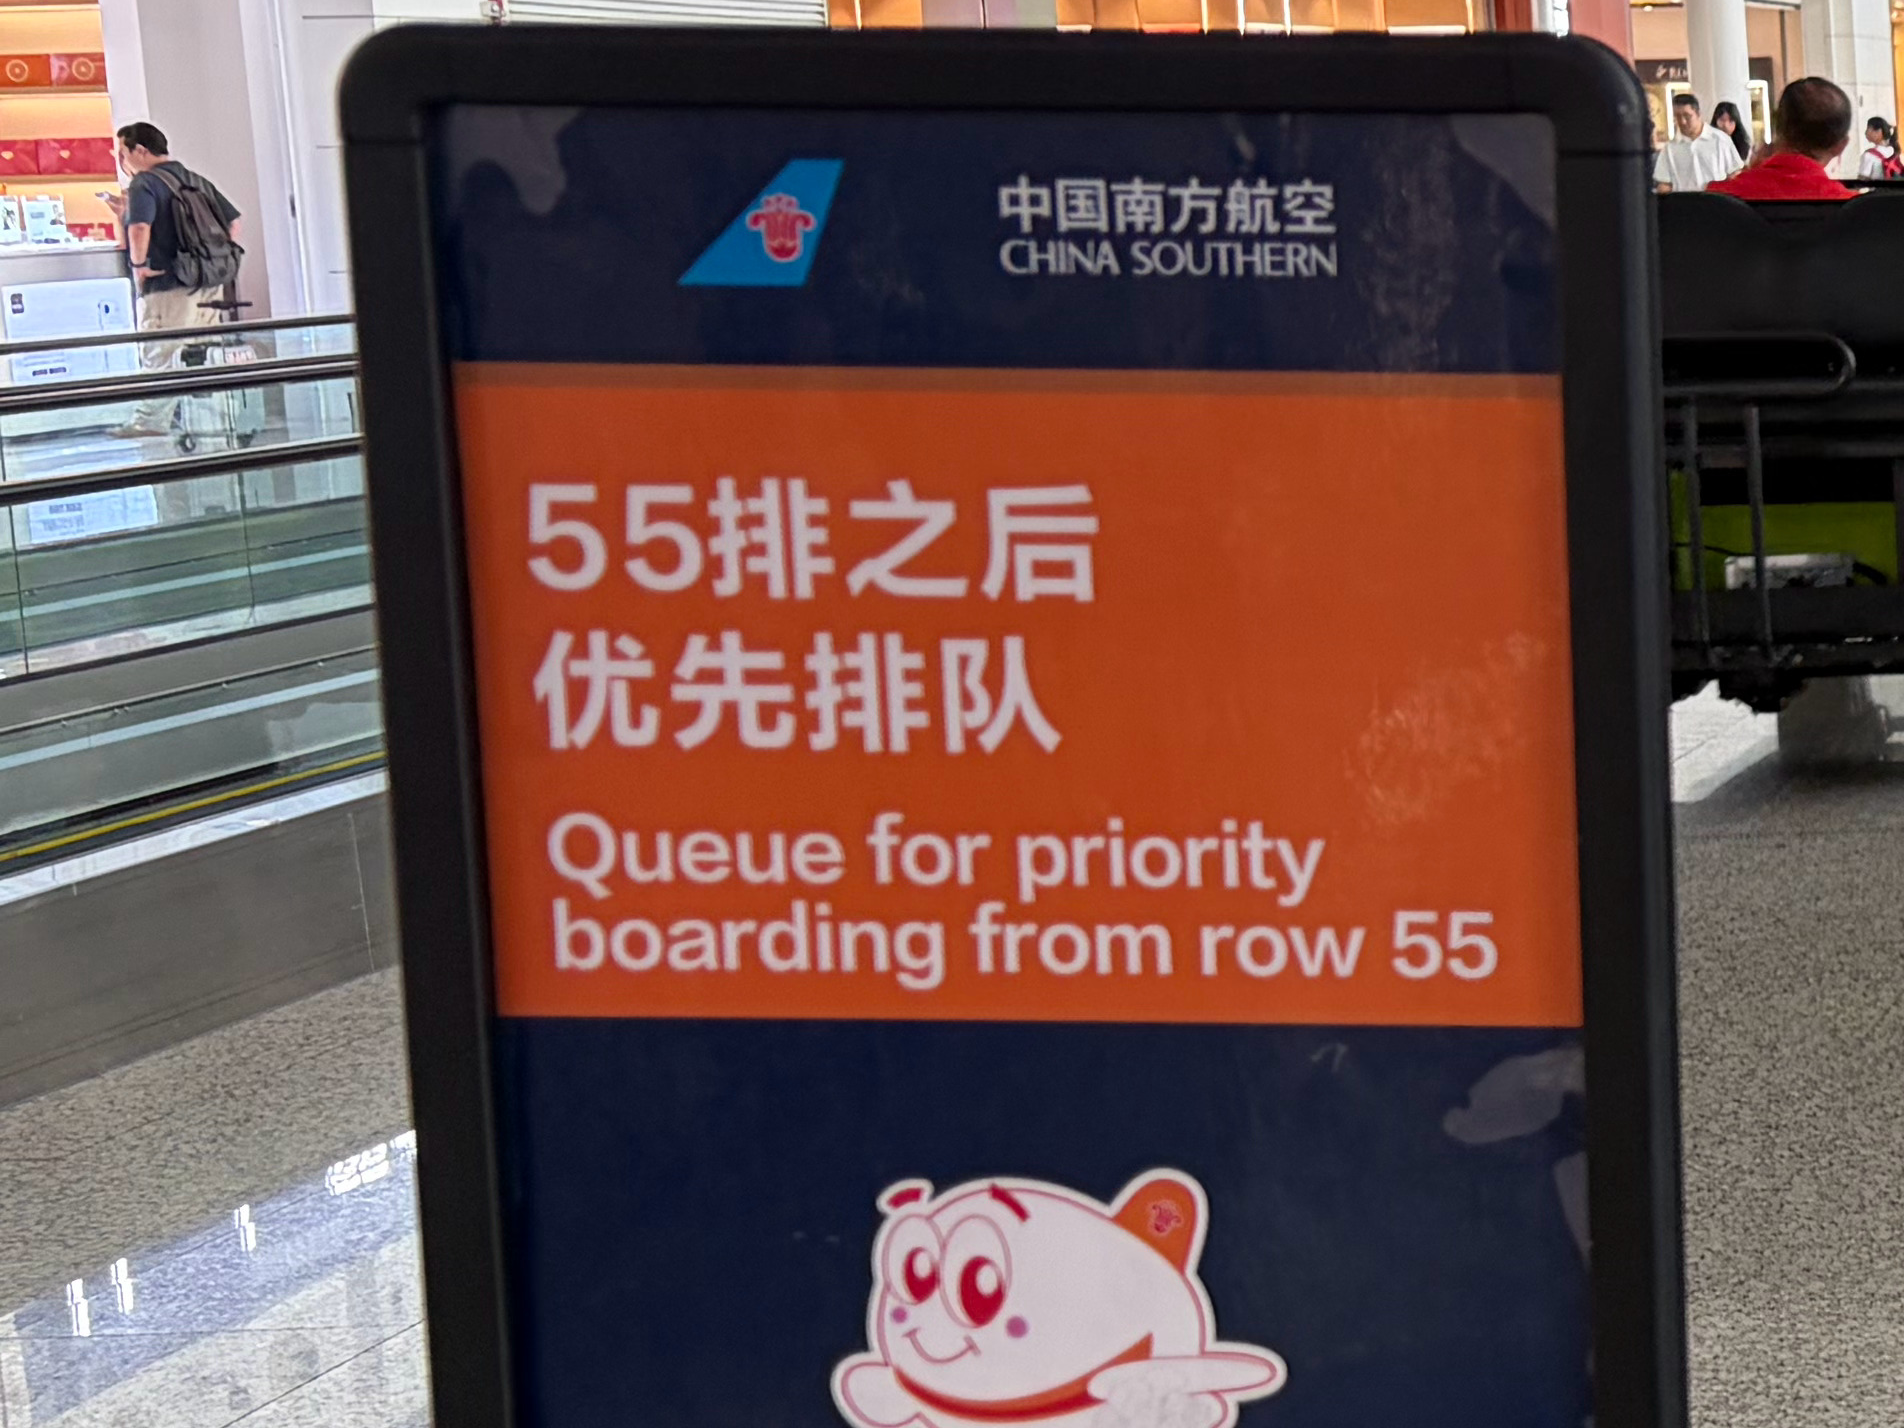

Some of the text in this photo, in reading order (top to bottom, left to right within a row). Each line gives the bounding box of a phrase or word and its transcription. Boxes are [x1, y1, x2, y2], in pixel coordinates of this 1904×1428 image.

[998, 175, 1338, 236] 中国南方航空
[998, 236, 1338, 279] CHINA SOUTHERN
[526, 478, 1102, 606] 55排之后
[533, 632, 1063, 756] 优先排队
[546, 813, 1326, 907] Queue for priority
[553, 904, 1499, 990] boarding from row 55
